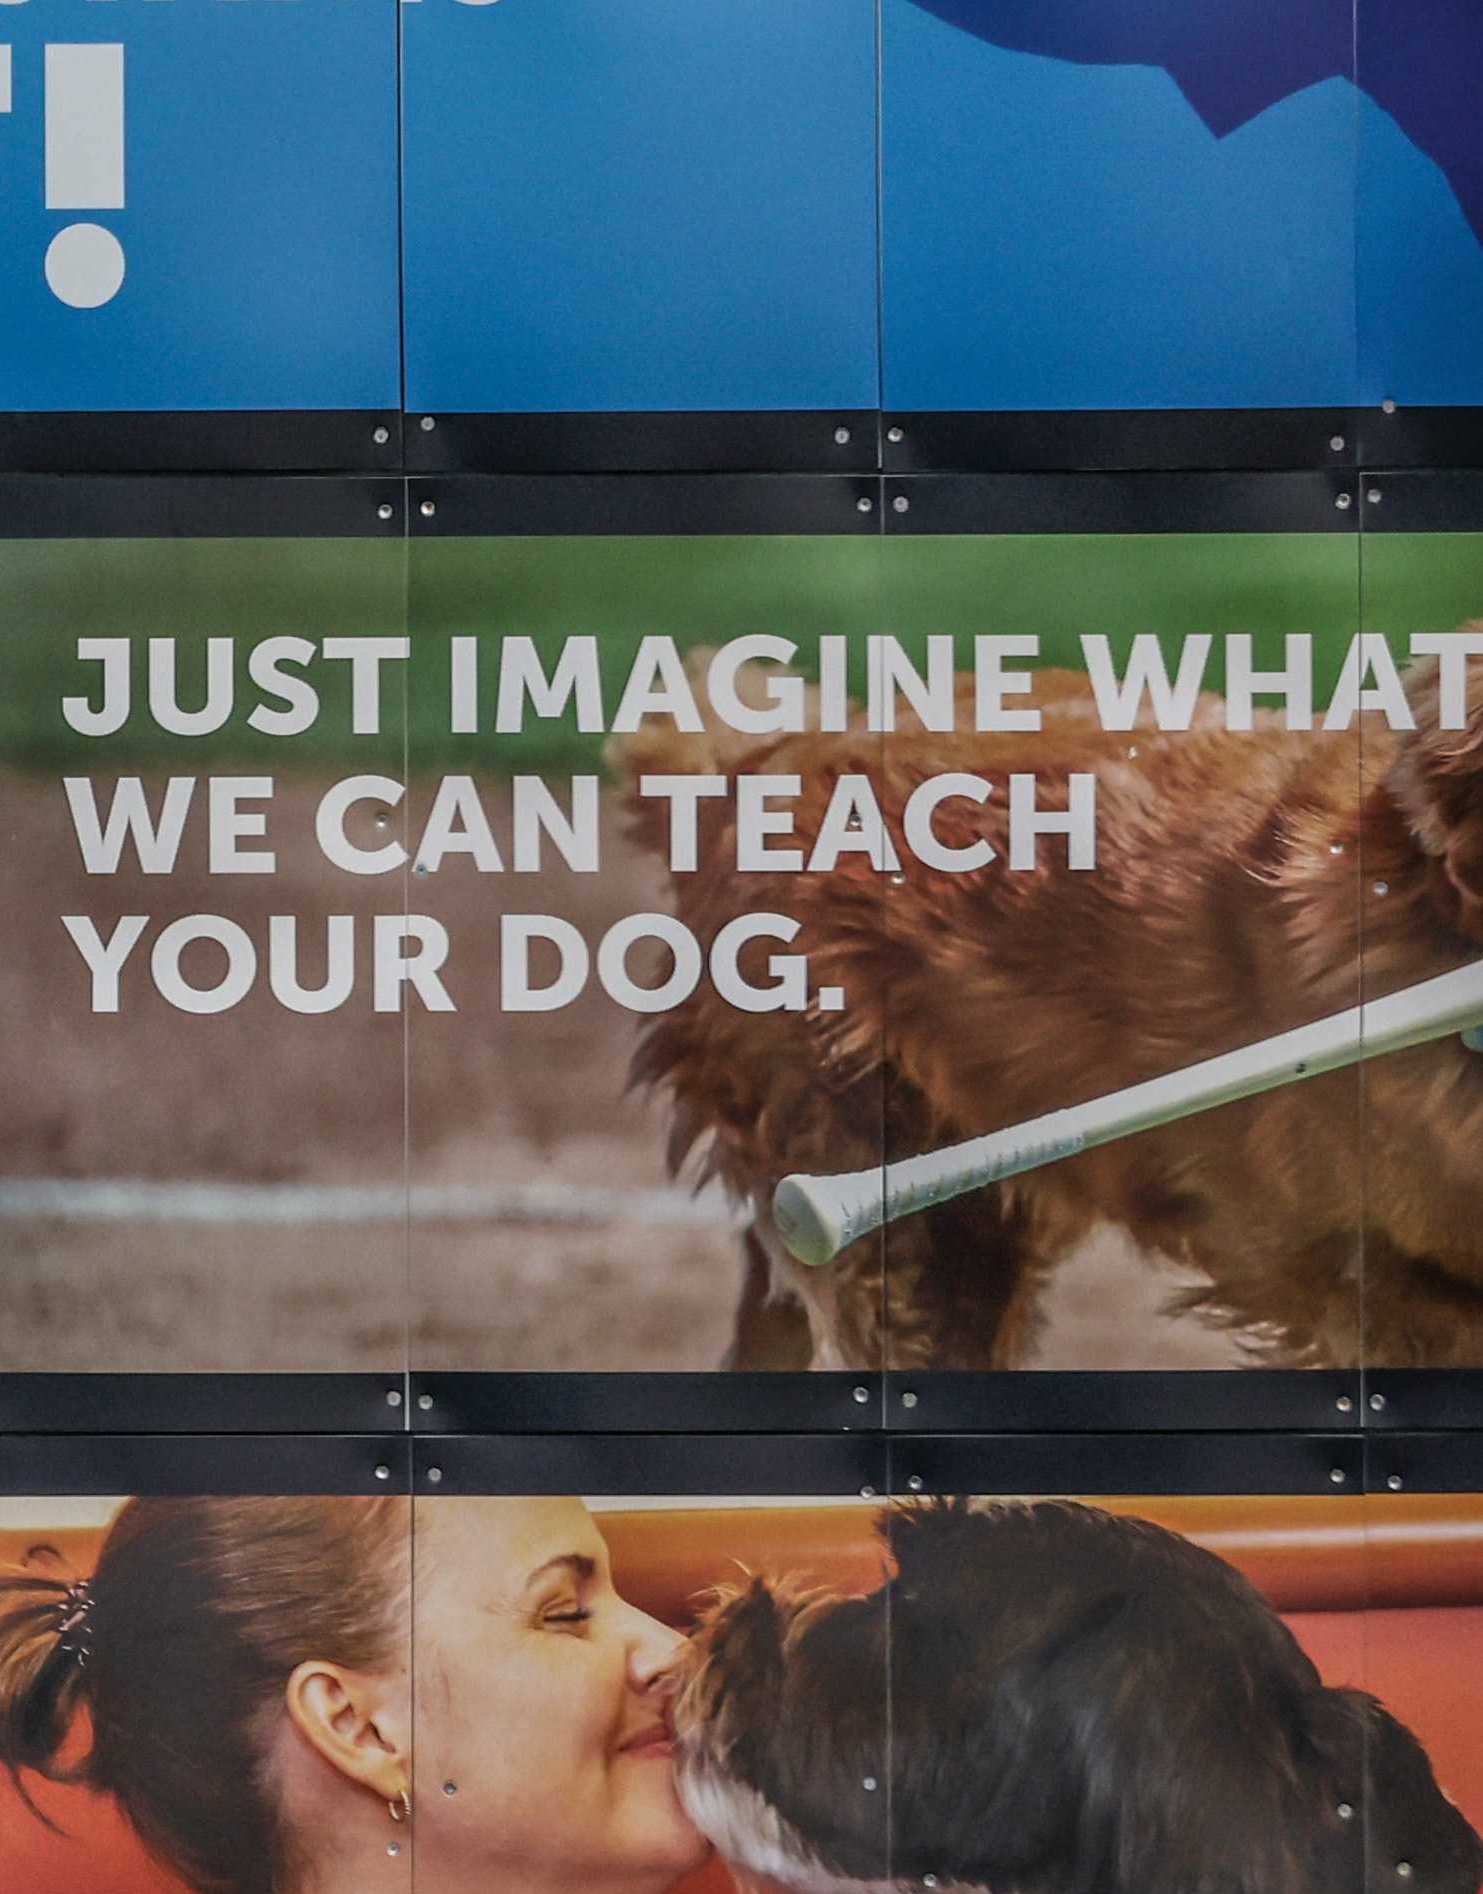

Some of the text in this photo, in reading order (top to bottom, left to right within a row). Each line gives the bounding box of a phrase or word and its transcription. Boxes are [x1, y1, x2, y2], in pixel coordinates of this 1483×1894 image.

[63, 633, 1483, 736] JUST IMAGINE WHAT
[64, 773, 1096, 874] WE CAN TEACH
[61, 913, 844, 1013] YOUR DOG.
